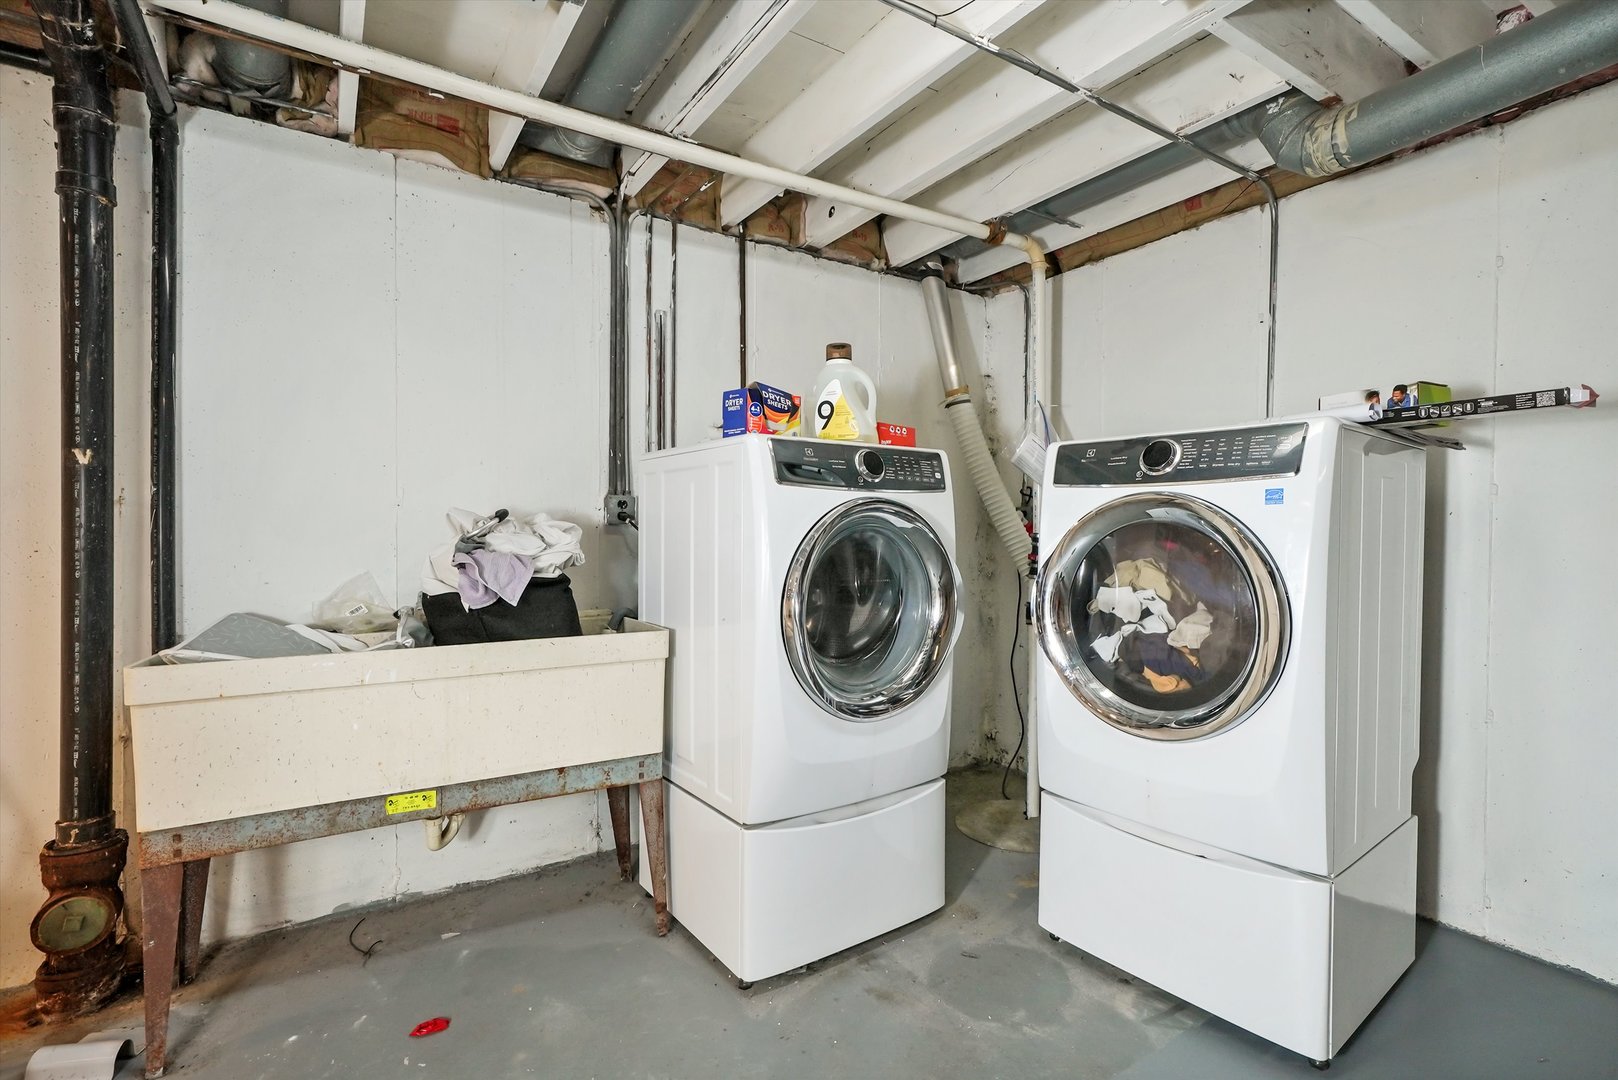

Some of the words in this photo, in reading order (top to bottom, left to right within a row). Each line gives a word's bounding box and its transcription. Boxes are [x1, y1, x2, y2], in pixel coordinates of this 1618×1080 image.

[725, 398, 744, 407] DRYER
[762, 390, 792, 407] DRYER
[767, 399, 788, 411] SHEETS
[817, 400, 835, 431] 9
